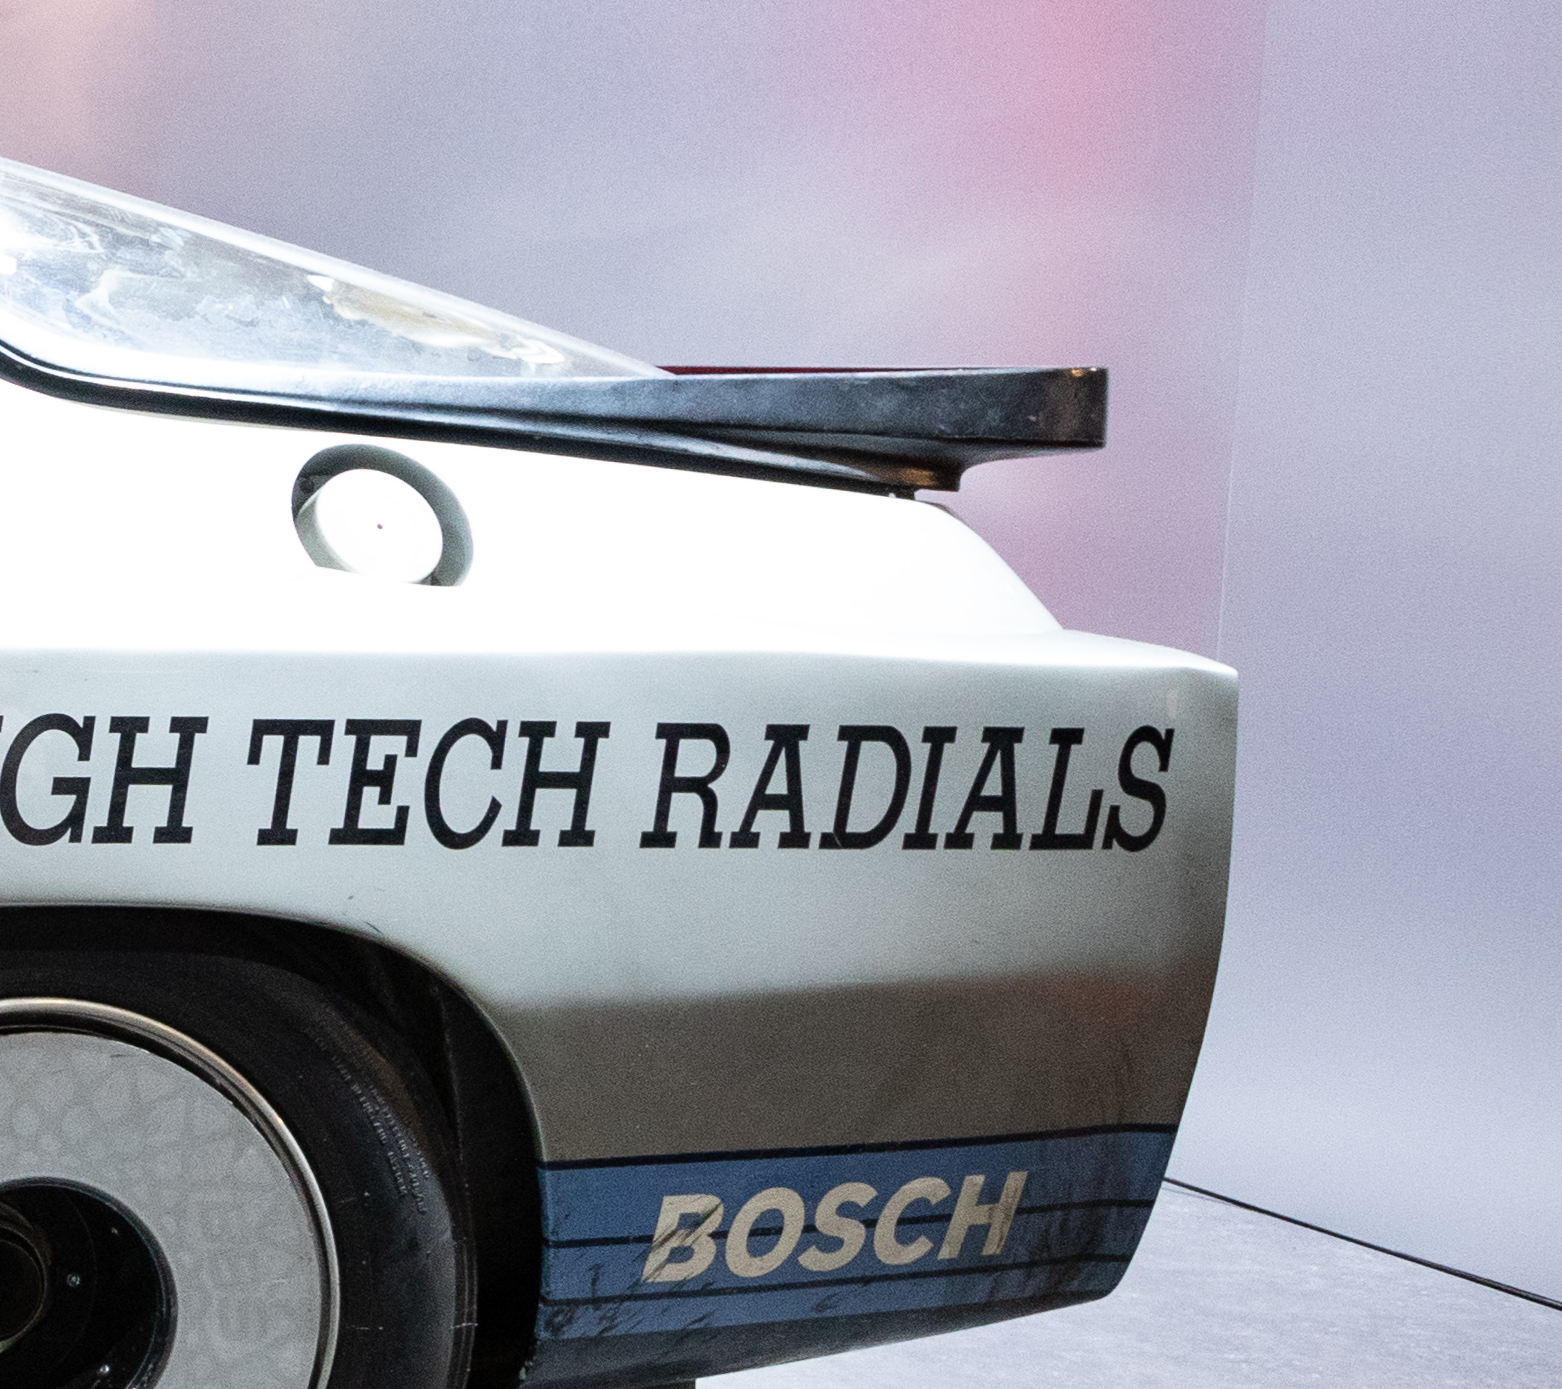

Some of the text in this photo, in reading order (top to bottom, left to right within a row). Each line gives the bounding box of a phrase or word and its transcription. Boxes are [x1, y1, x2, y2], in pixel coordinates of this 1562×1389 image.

[247, 717, 613, 849] TECH
[640, 722, 1176, 853] RADIALS
[643, 1171, 1029, 1283] BOSCH
